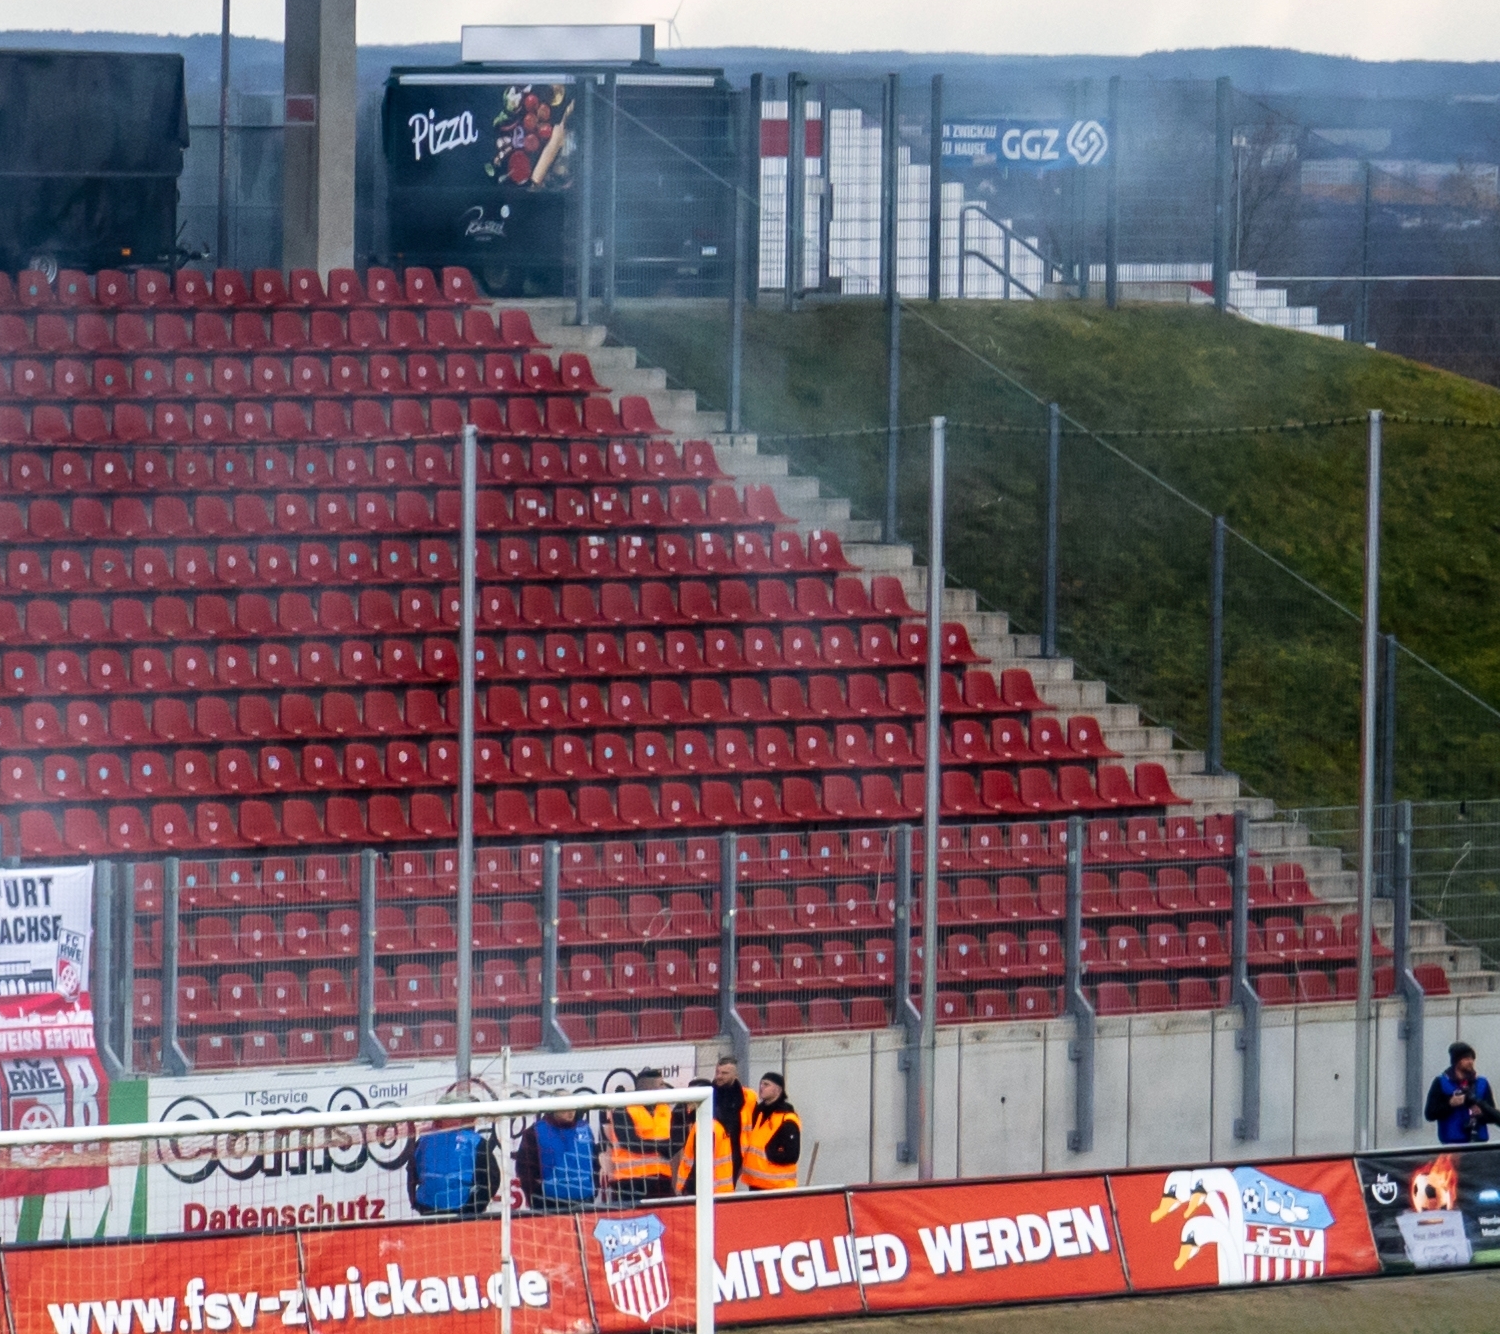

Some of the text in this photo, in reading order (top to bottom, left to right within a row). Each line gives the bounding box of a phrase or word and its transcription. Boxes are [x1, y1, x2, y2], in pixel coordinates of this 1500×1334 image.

[408, 107, 479, 161] Pizza
[1001, 128, 1060, 160] GGZ
[8, 1067, 63, 1092] RWE
[521, 1070, 584, 1087] IT-Service
[245, 1083, 408, 1107] IT-Service GmbH
[183, 1193, 387, 1233] Datenschutz
[1245, 1224, 1315, 1245] FSV
[610, 1242, 655, 1275] FSV
[712, 1204, 1111, 1304] MITGLIED WERDEN
[1253, 1245, 1308, 1261] ZWICKAU
